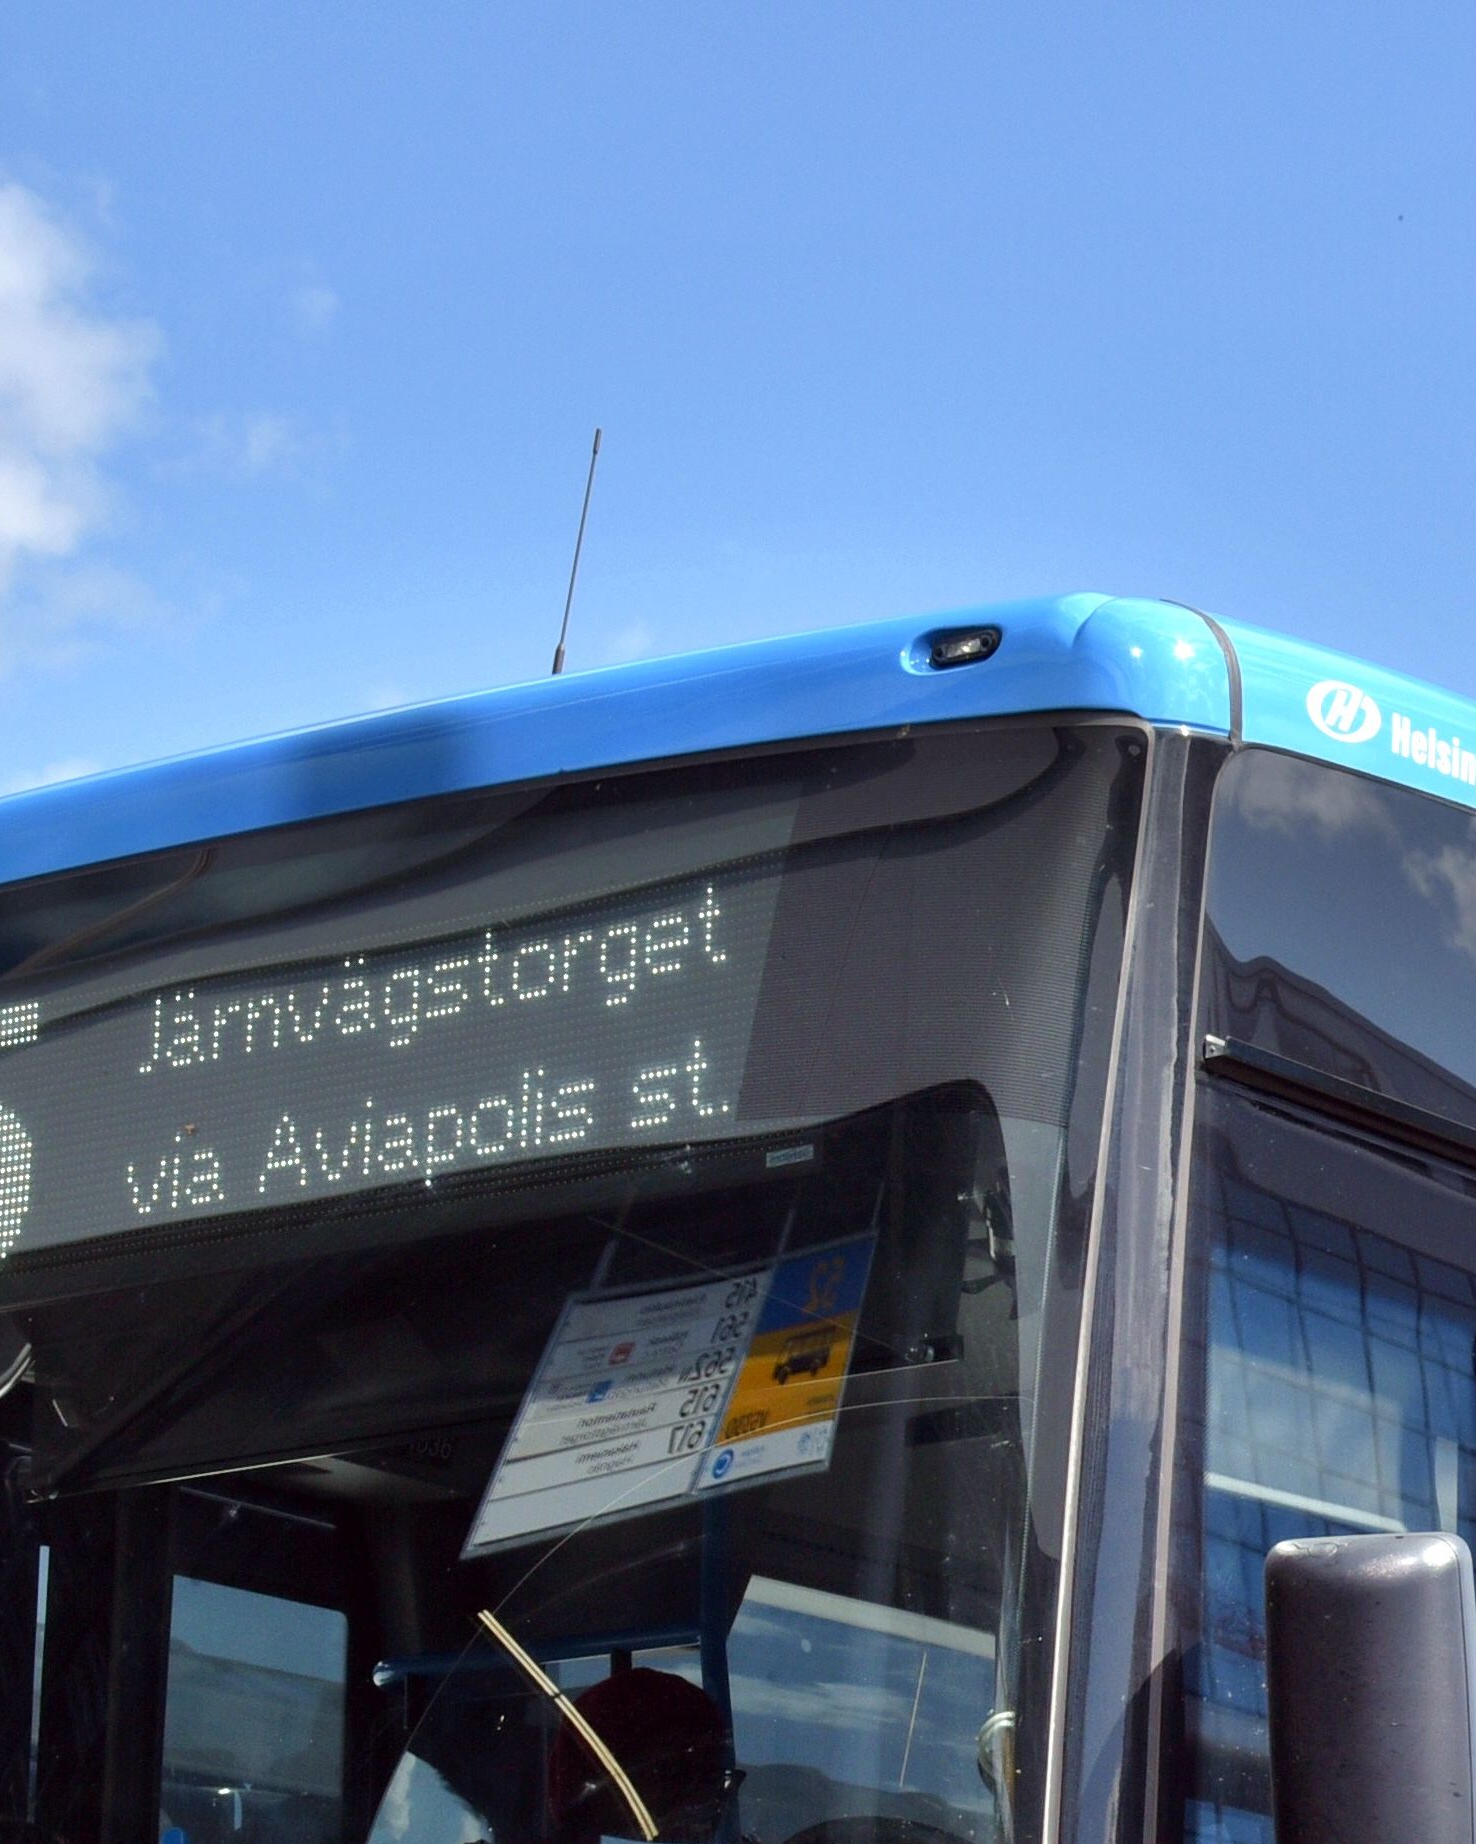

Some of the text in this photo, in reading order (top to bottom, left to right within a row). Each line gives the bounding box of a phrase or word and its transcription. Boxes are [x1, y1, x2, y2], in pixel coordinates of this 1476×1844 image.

[139, 883, 729, 1073] Järnvägstorget
[125, 1037, 729, 1216] via Aviapolis st.
